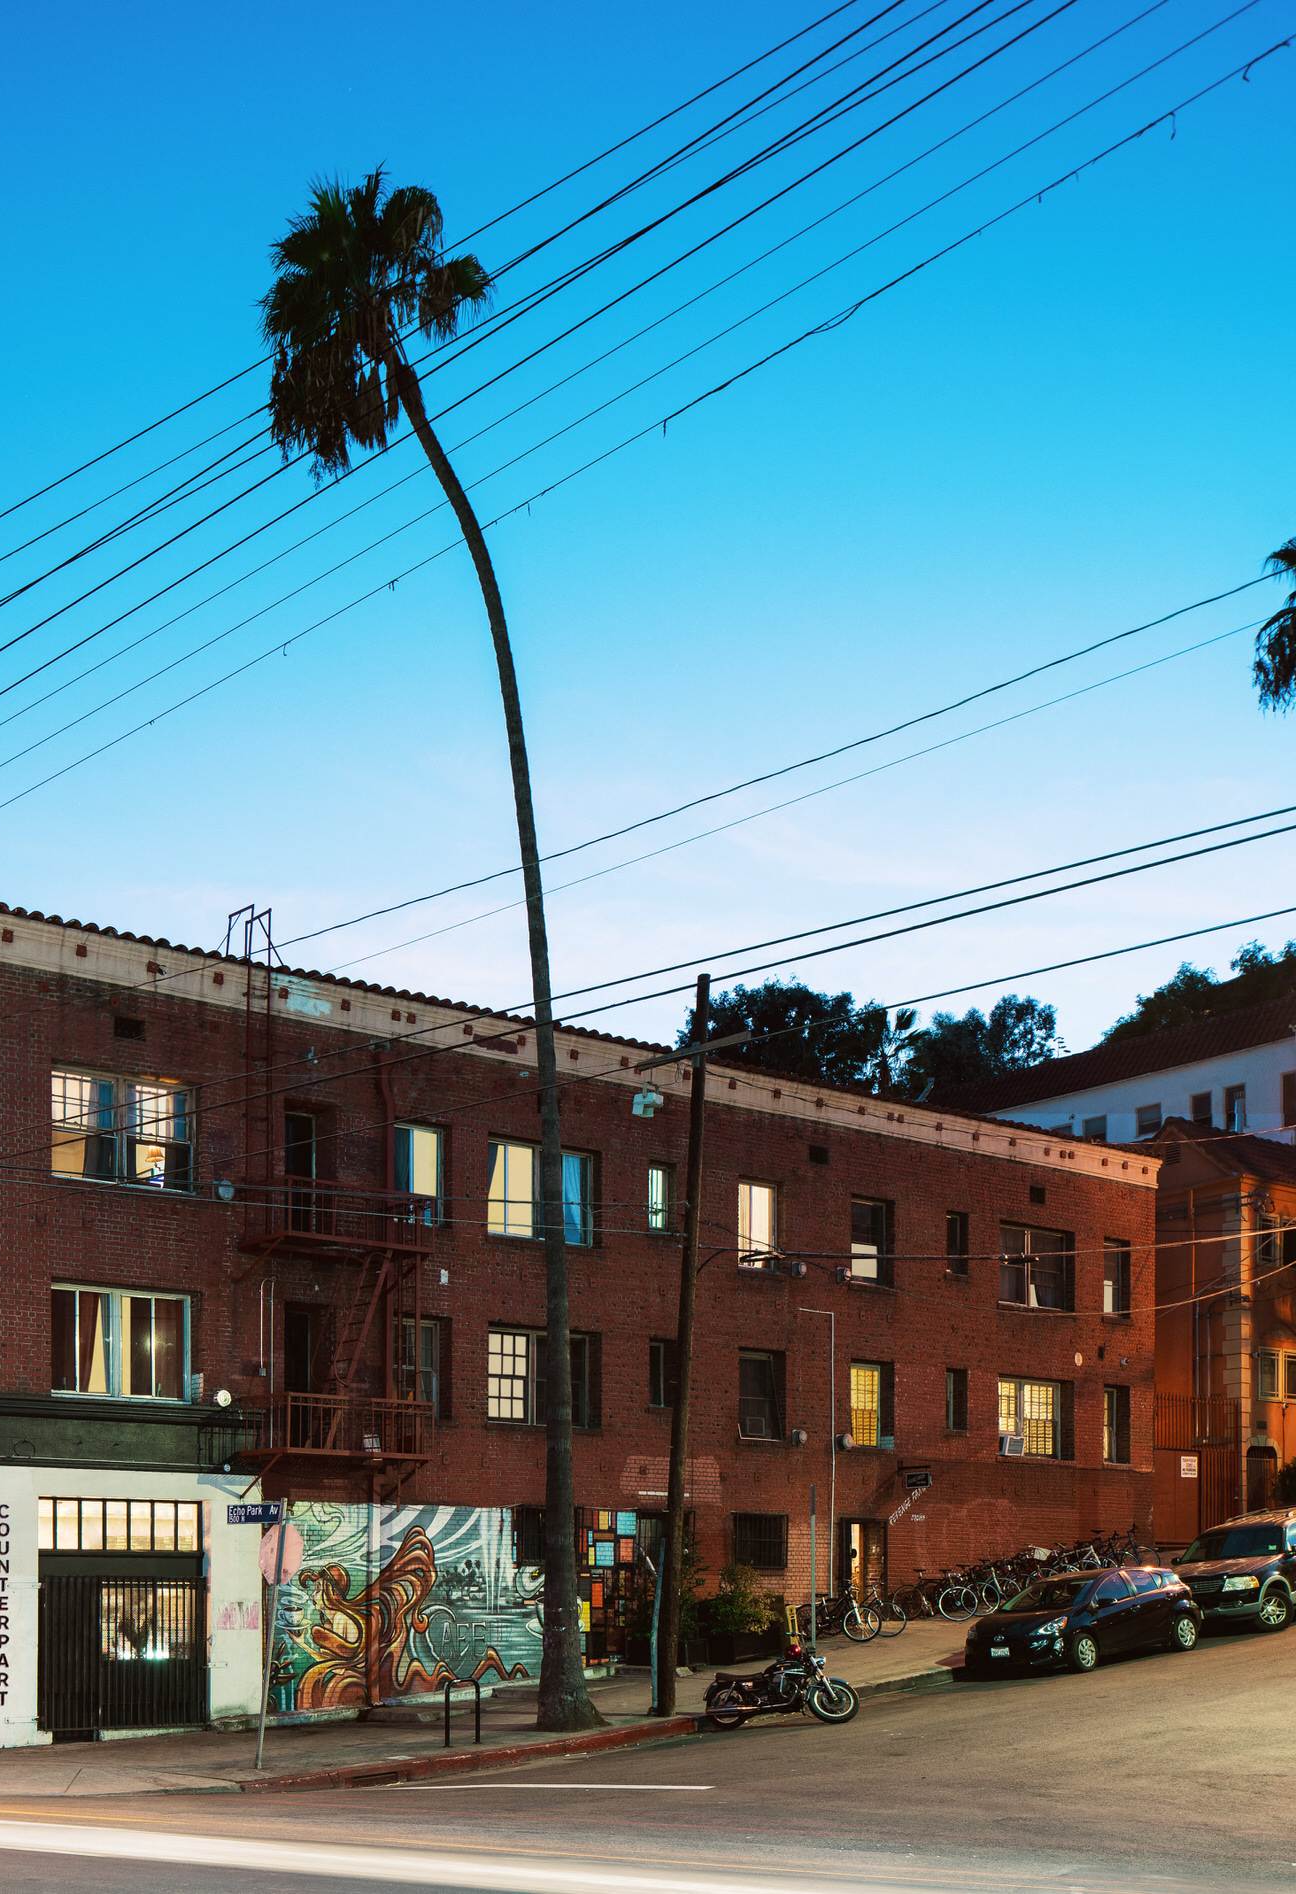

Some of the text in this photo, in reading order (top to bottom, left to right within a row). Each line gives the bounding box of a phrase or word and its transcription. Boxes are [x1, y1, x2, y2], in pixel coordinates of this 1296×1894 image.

[229, 1504, 279, 1515] Echo Park Av
